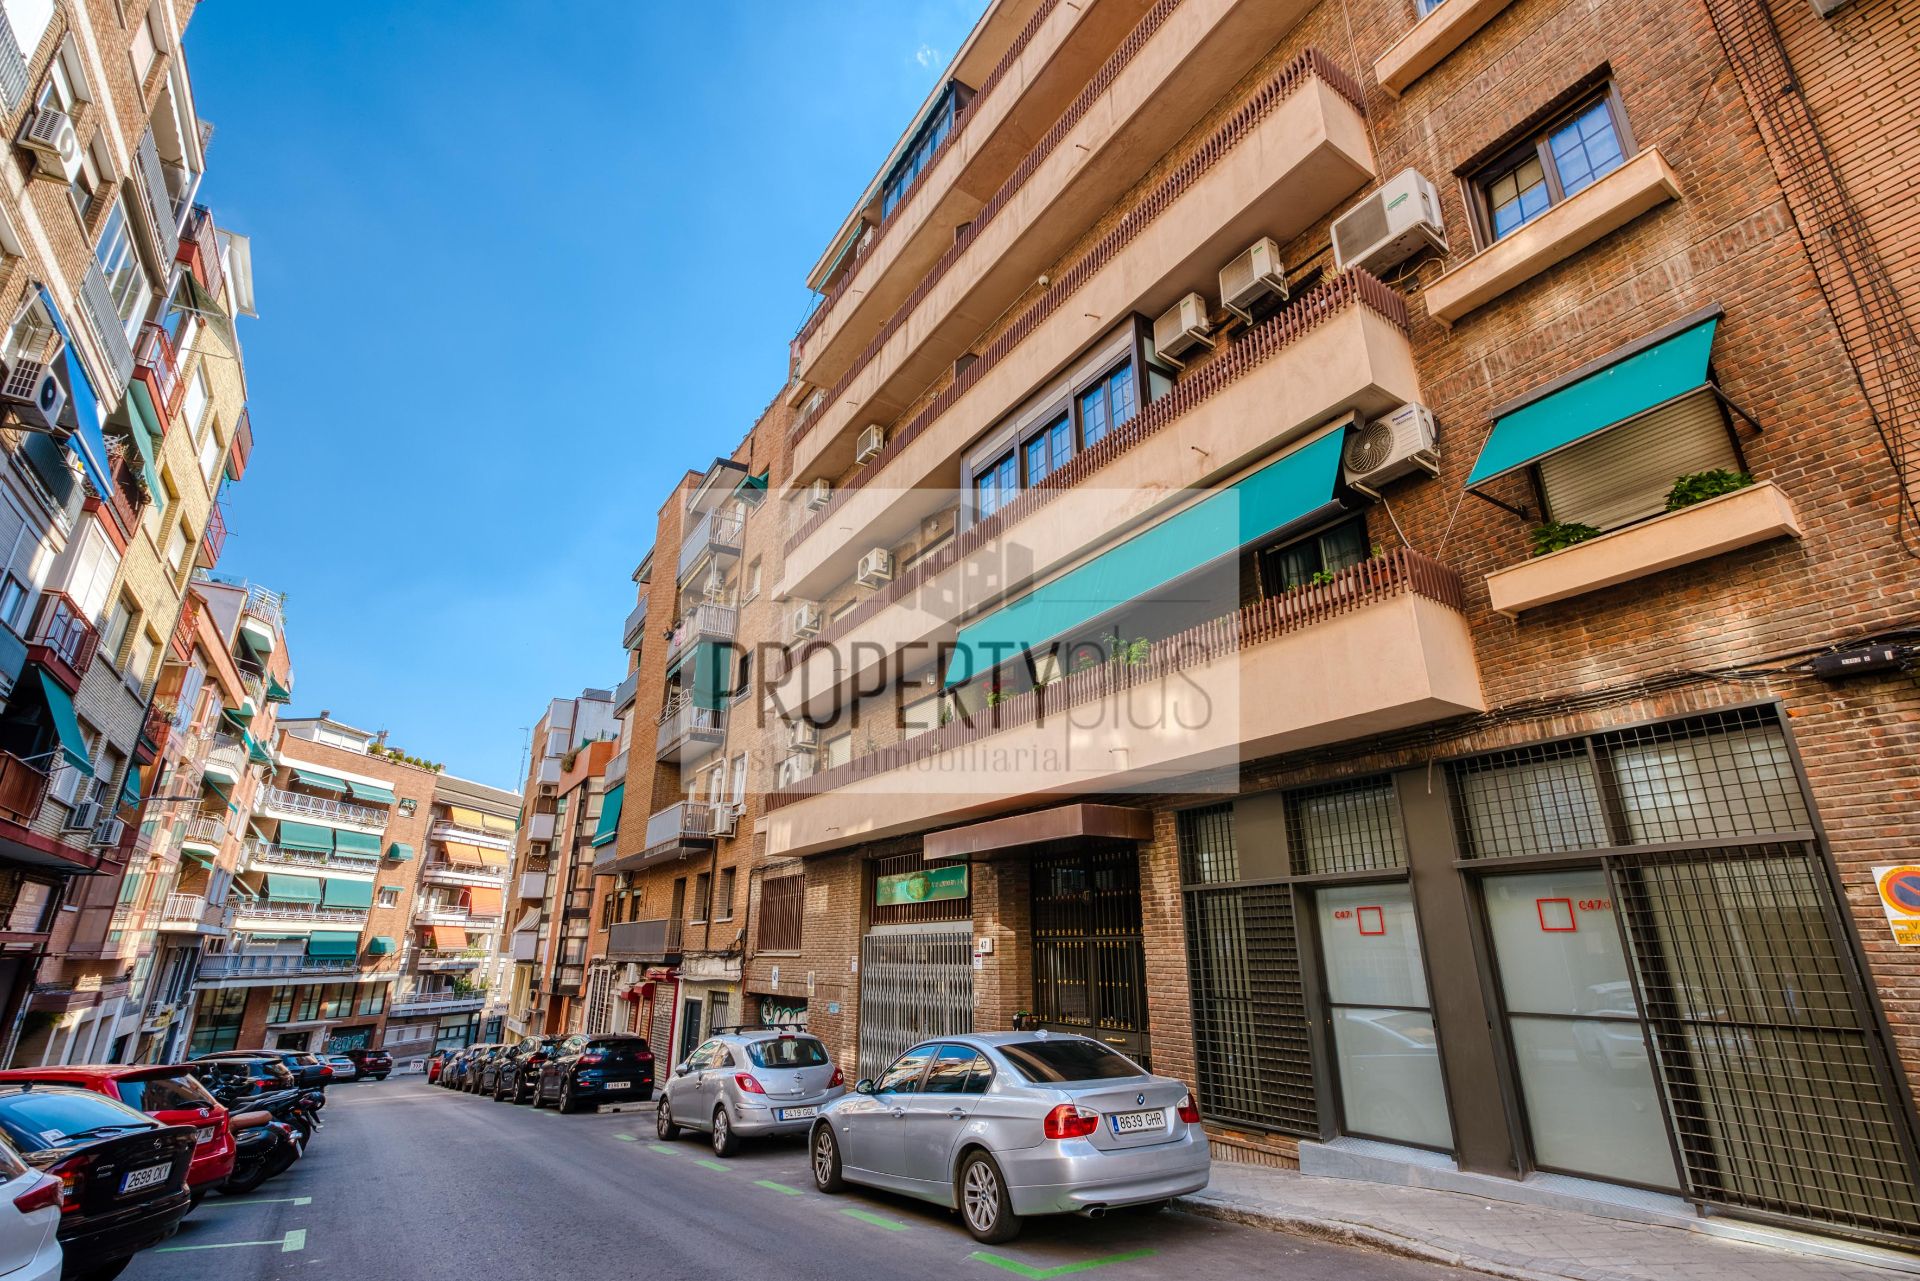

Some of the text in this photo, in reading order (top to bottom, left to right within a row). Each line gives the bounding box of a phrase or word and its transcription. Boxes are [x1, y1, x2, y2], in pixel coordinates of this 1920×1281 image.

[1120, 1112, 1163, 1129] 8639 GHR
[128, 1164, 170, 1188] 2698 CKY
